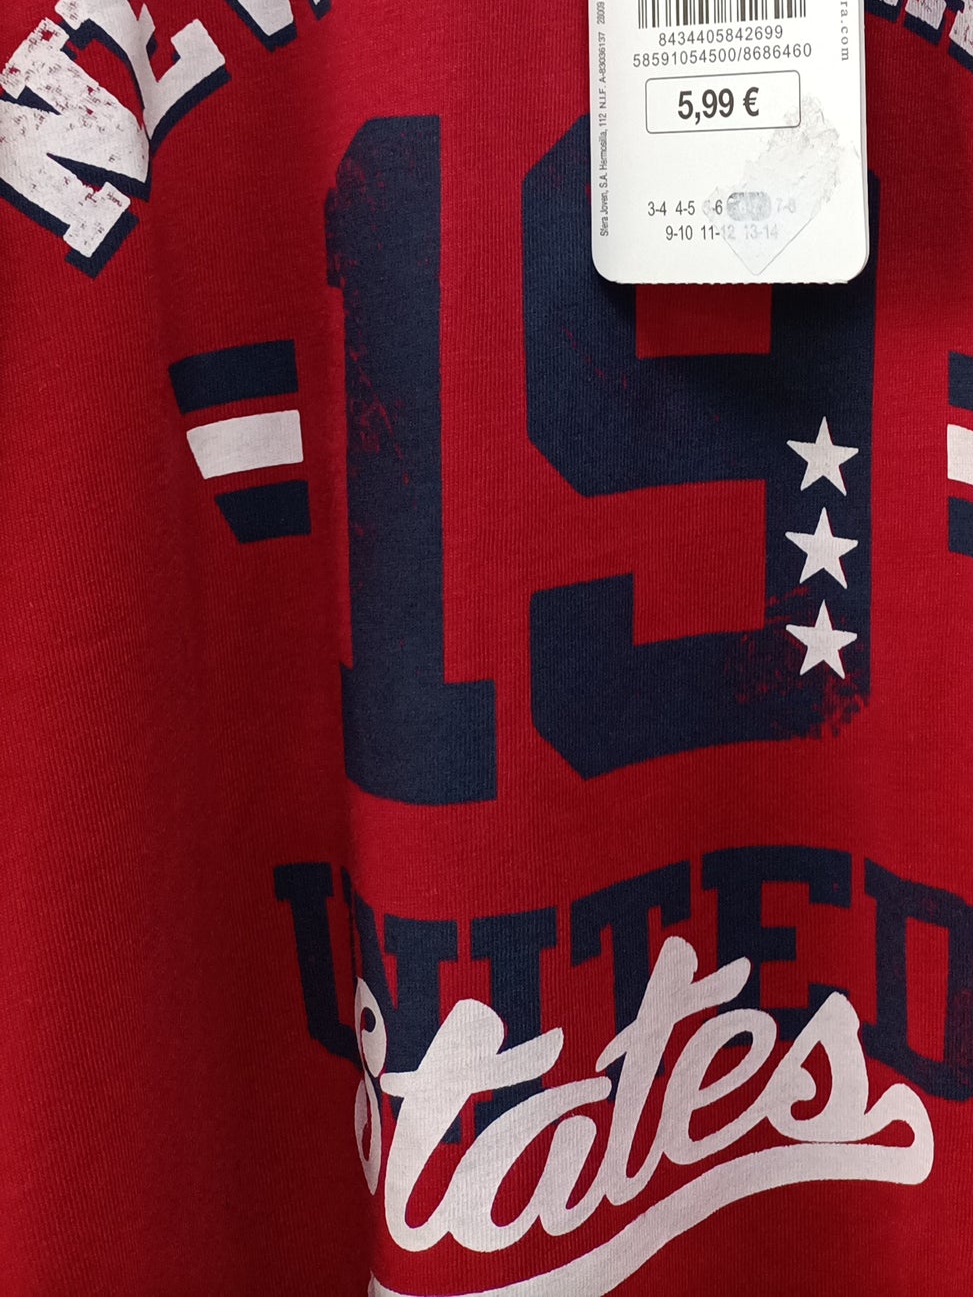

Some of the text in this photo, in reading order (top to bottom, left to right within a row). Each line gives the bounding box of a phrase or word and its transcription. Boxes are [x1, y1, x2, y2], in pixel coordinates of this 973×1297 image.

[658, 24, 784, 47] 8434405842699
[632, 43, 813, 68] 58591054500/8686460
[598, 84, 607, 109] N.I.F.
[677, 86, 760, 125] 5,99 €
[599, 113, 607, 127] 112
[600, 190, 609, 215] Joven,
[647, 200, 667, 216] 3-4
[675, 200, 696, 216] 4-5
[600, 216, 609, 237] Sfera
[665, 224, 778, 241] 9-10 11-12 13-14
[325, 113, 880, 806] 19
[354, 935, 935, 1253] States
